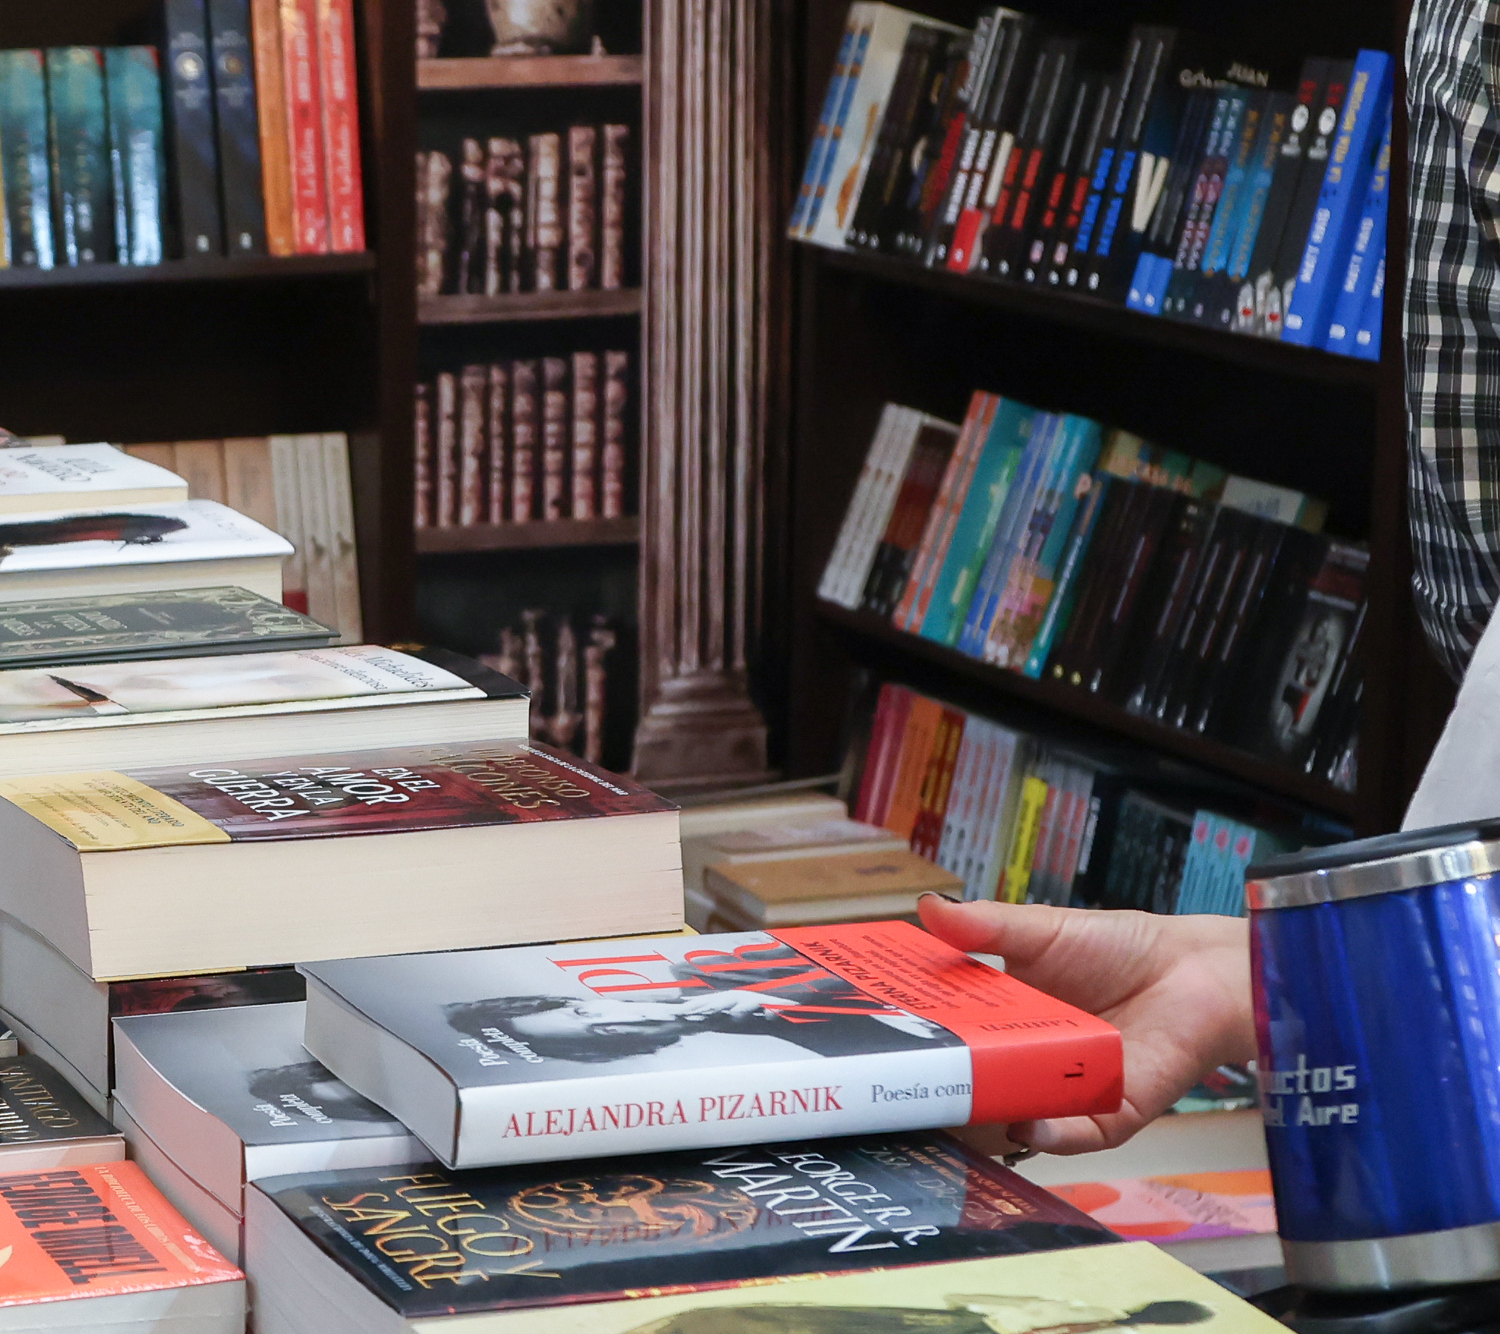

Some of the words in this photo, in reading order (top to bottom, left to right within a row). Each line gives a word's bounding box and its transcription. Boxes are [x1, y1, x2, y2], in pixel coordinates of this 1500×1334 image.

[188, 769, 310, 821] GUERRA
[300, 767, 409, 806] AMOR
[801, 941, 878, 983] PIZARNIK
[875, 978, 936, 1011] ETERNA
[501, 1101, 690, 1142] ALEJANDRA
[697, 1084, 843, 1126] PIZARNIK
[871, 1077, 932, 1105] Poesía
[1297, 1098, 1359, 1126] Aire
[380, 1174, 534, 1259] FUEGO
[702, 1156, 902, 1255] MARTIN
[323, 1194, 490, 1288] SANGRE
